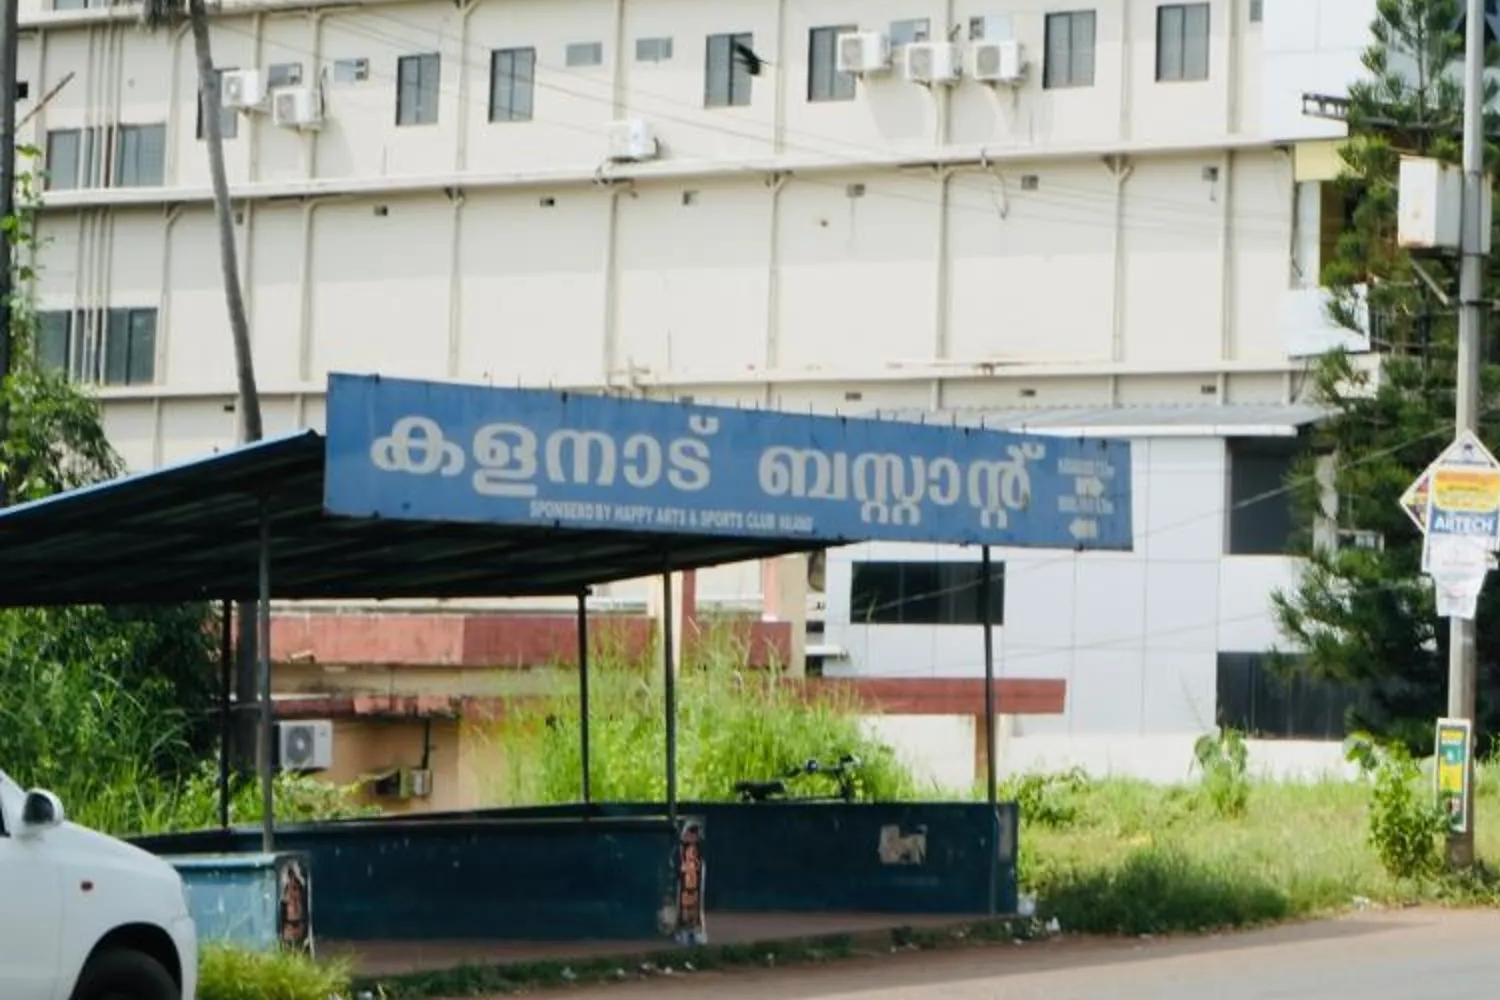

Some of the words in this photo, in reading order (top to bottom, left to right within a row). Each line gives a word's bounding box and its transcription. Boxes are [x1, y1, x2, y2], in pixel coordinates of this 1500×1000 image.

[369, 414, 720, 498] കളനാട്
[614, 504, 655, 525] HAPPY
[700, 509, 743, 530] SPORTS
